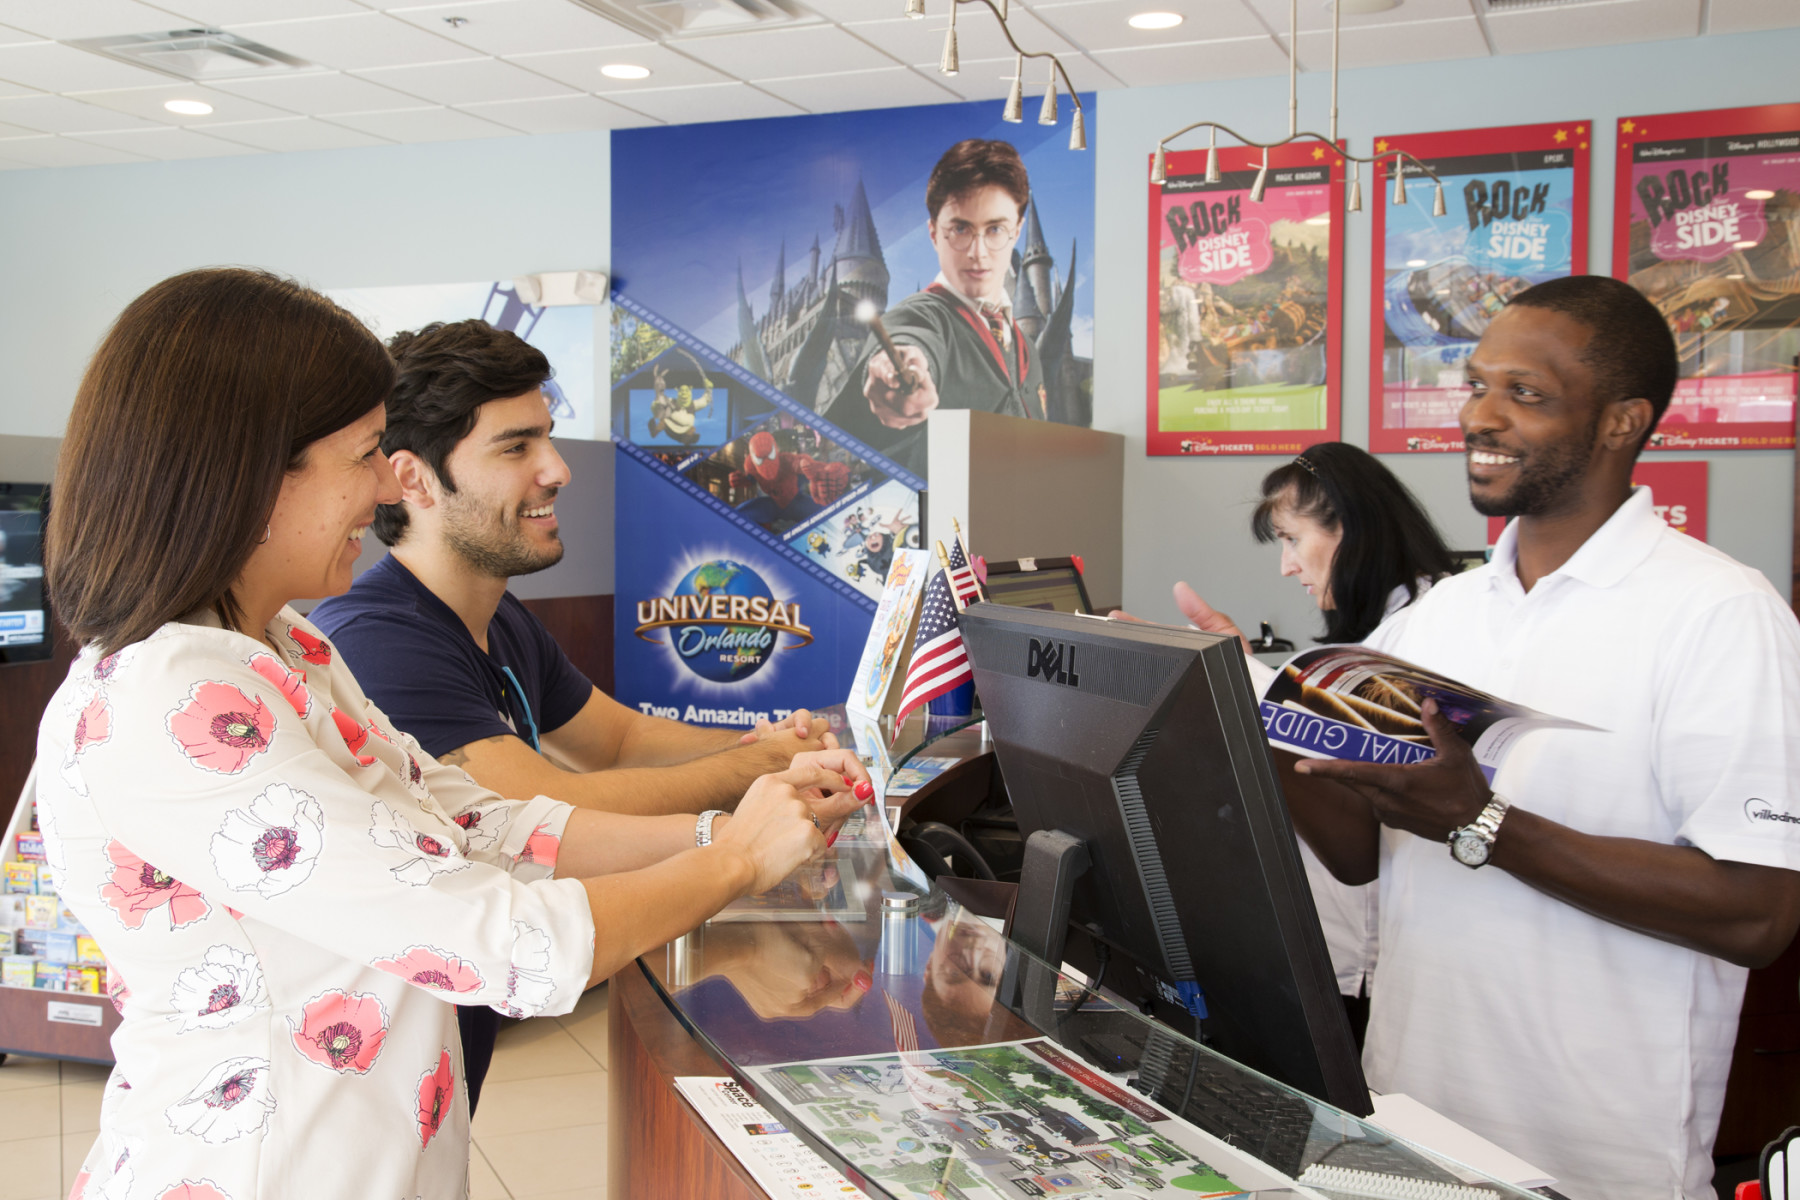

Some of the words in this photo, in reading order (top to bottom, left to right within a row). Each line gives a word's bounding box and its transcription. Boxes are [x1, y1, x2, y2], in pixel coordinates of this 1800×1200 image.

[1463, 179, 1550, 232] ROCK
[1636, 162, 1729, 229] ROCK
[1165, 194, 1241, 254] ROCK
[1675, 203, 1740, 226] DISNEY
[1198, 231, 1250, 251] DISNEY
[1491, 222, 1551, 237] DISNEY
[1676, 218, 1741, 249] SIDE
[1200, 245, 1252, 273] SIDE
[1487, 236, 1547, 261] SIDE
[1220, 443, 1254, 452] TICKETS
[1255, 443, 1277, 451] SOLD
[1278, 443, 1302, 451] HERE
[1698, 436, 1740, 445] TICKETS
[1741, 436, 1768, 445] SOLD
[636, 594, 812, 633] UNIVERSAL
[678, 625, 772, 657] Orlando
[720, 654, 762, 664] RESORT
[1027, 637, 1079, 687] DELL
[639, 702, 680, 721] Two
[683, 704, 770, 725] Amazing
[1262, 705, 1348, 750] GUIDE
[723, 1081, 754, 1108] Space
